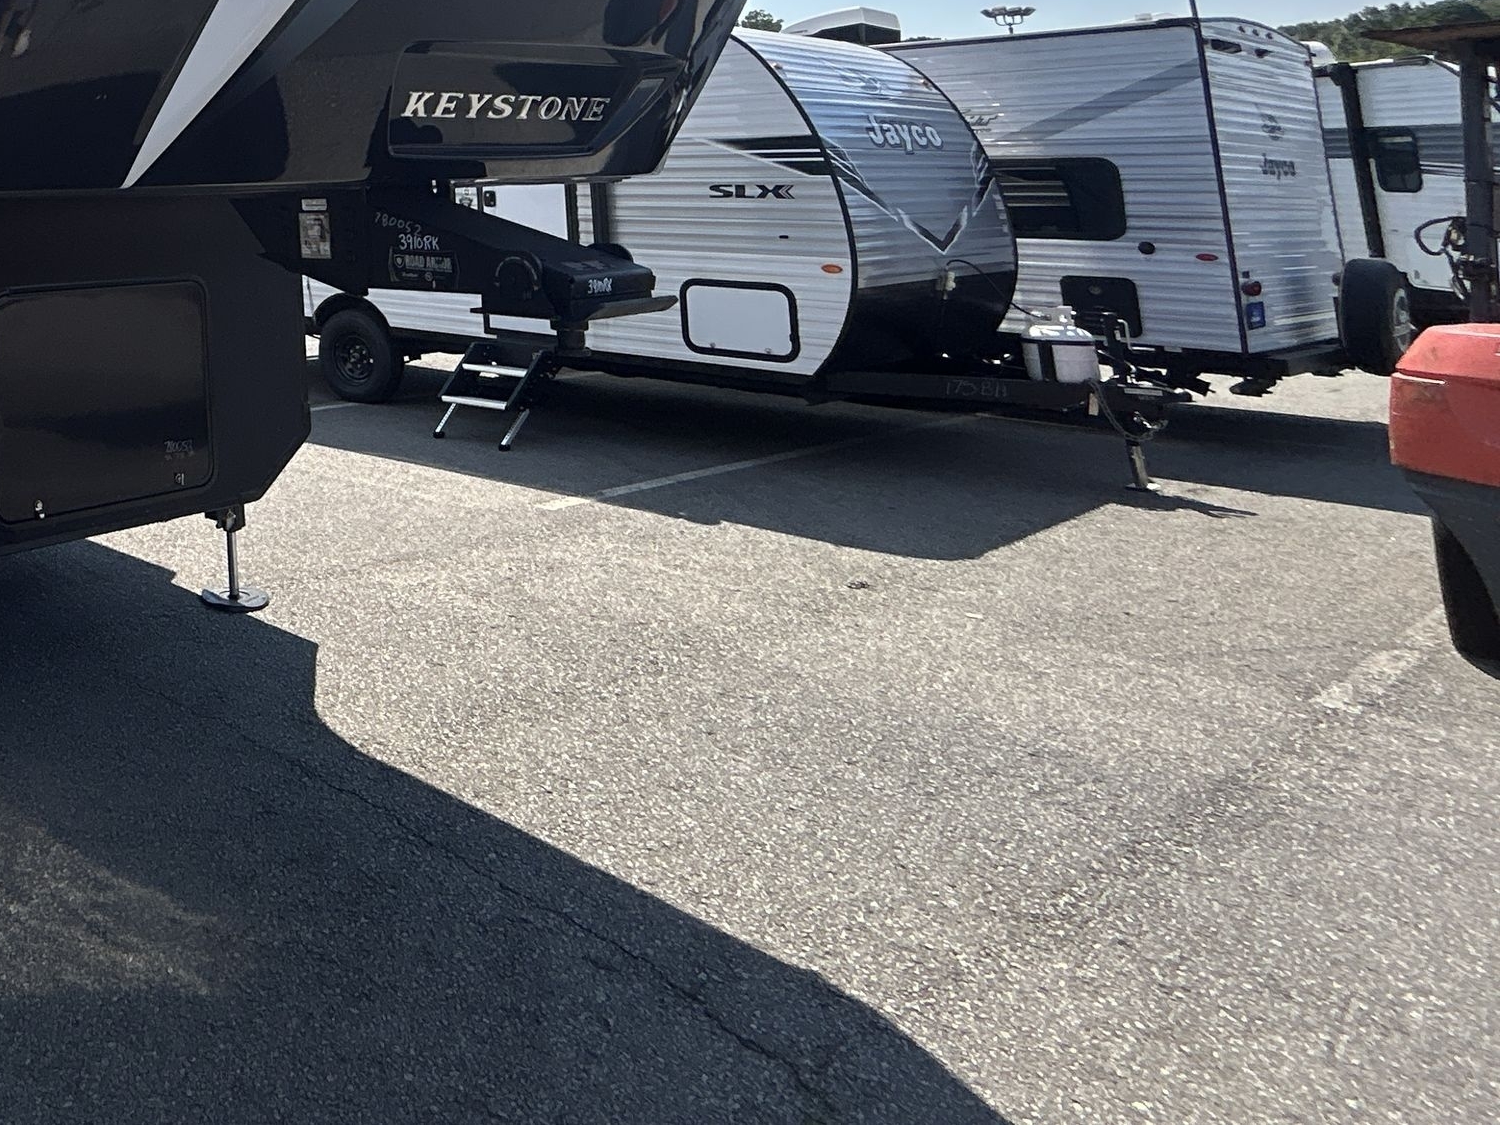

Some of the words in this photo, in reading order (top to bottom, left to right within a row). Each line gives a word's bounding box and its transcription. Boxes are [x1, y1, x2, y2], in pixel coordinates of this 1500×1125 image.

[400, 91, 611, 122] KEYSTONE
[866, 113, 943, 155] Jayco
[708, 184, 796, 200] SLX
[398, 233, 440, 251] 3910RK
